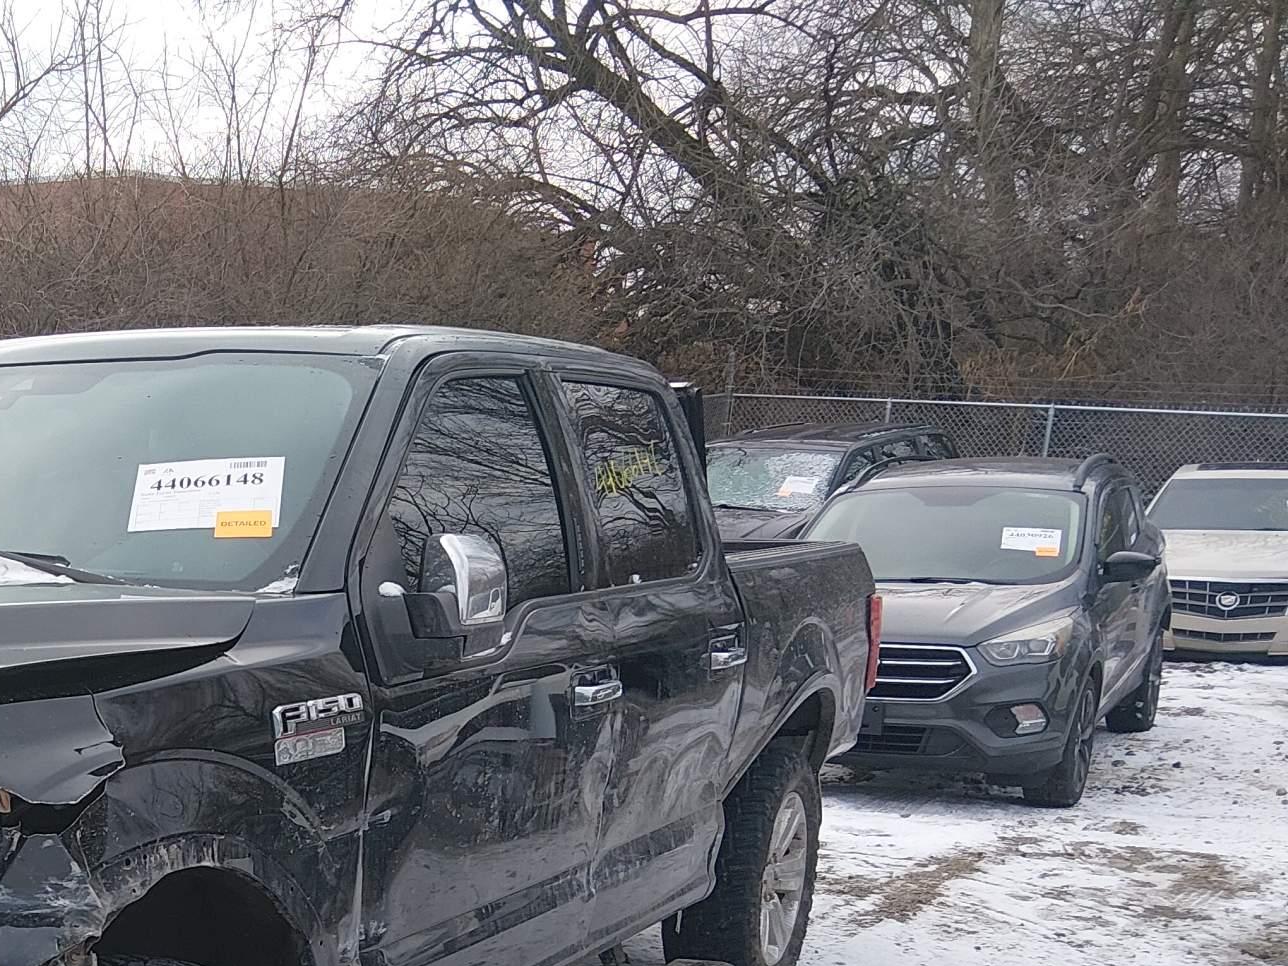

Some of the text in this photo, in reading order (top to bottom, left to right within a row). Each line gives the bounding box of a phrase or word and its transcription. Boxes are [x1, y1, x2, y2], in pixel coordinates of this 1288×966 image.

[150, 473, 264, 491] 44066148
[220, 519, 267, 527] DETAILED
[330, 713, 362, 726] LARIAT
